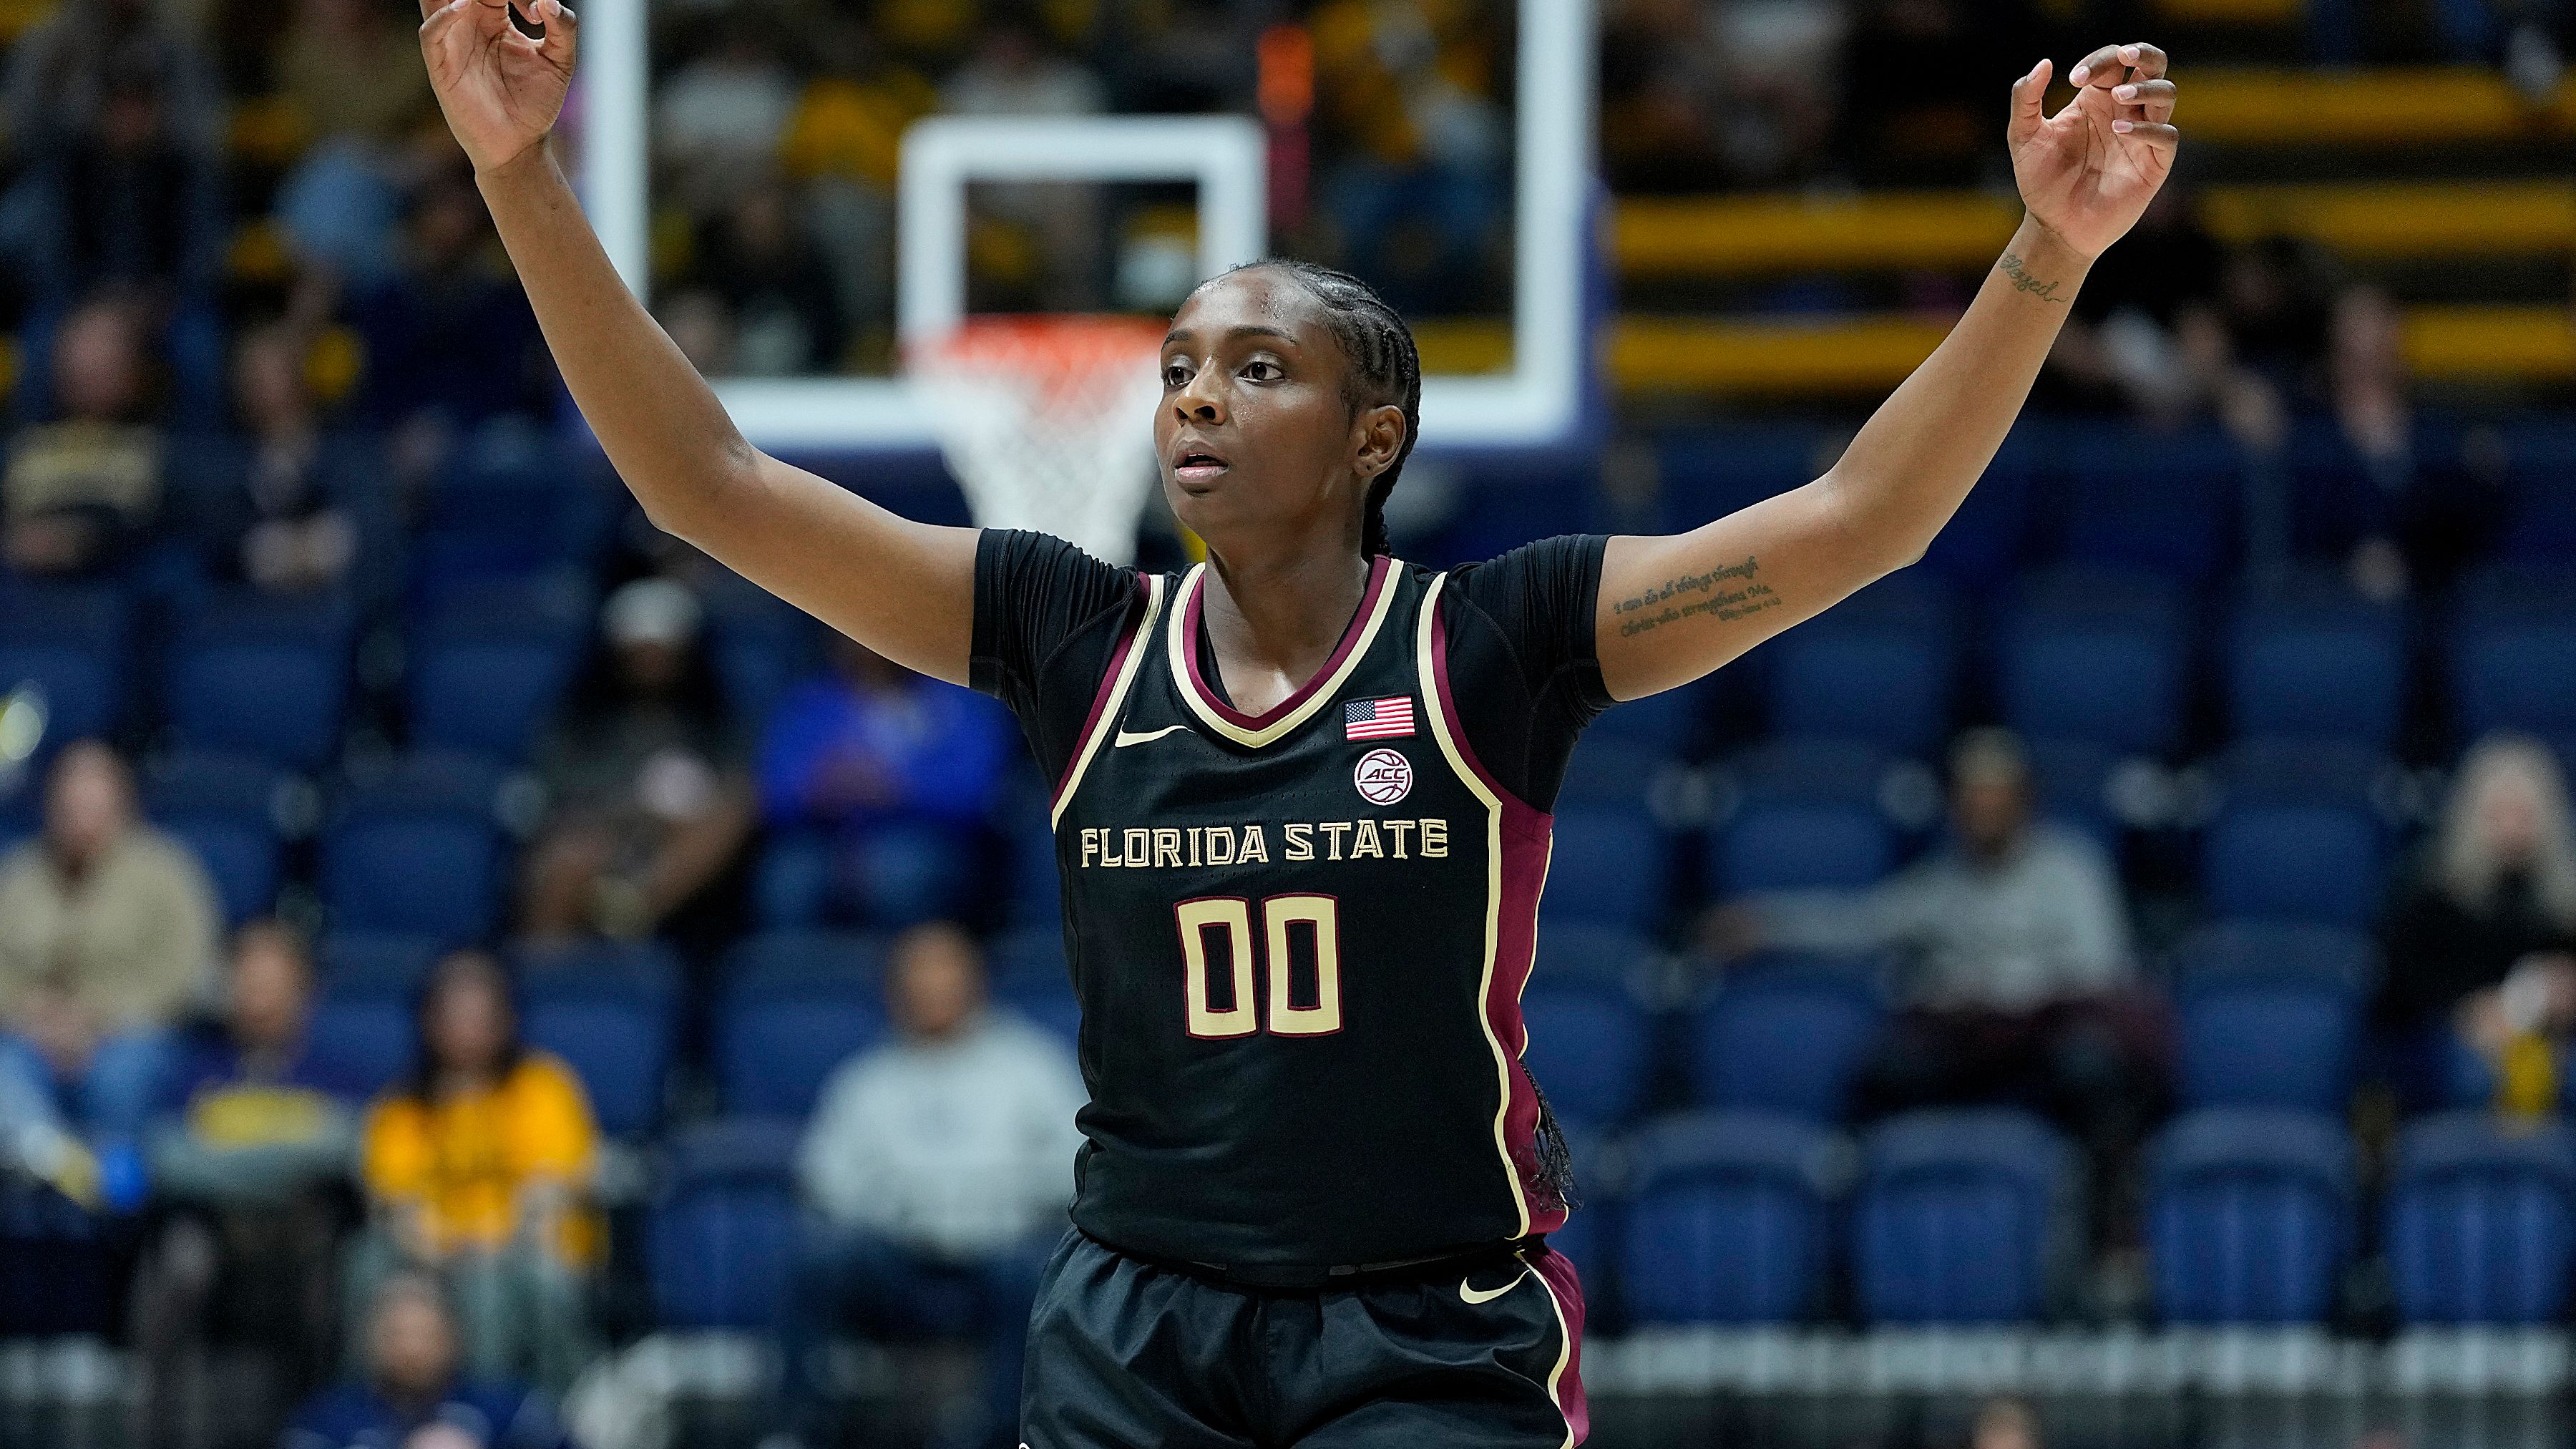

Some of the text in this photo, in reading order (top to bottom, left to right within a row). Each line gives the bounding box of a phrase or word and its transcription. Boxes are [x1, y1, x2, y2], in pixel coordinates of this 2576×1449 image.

[1614, 555, 1758, 615] I can do all things through
[1655, 608, 1680, 625] who
[1365, 767, 1407, 780] ACC
[1080, 819, 1448, 868] FLORIDA STATE
[1174, 892, 1344, 1040] 00
